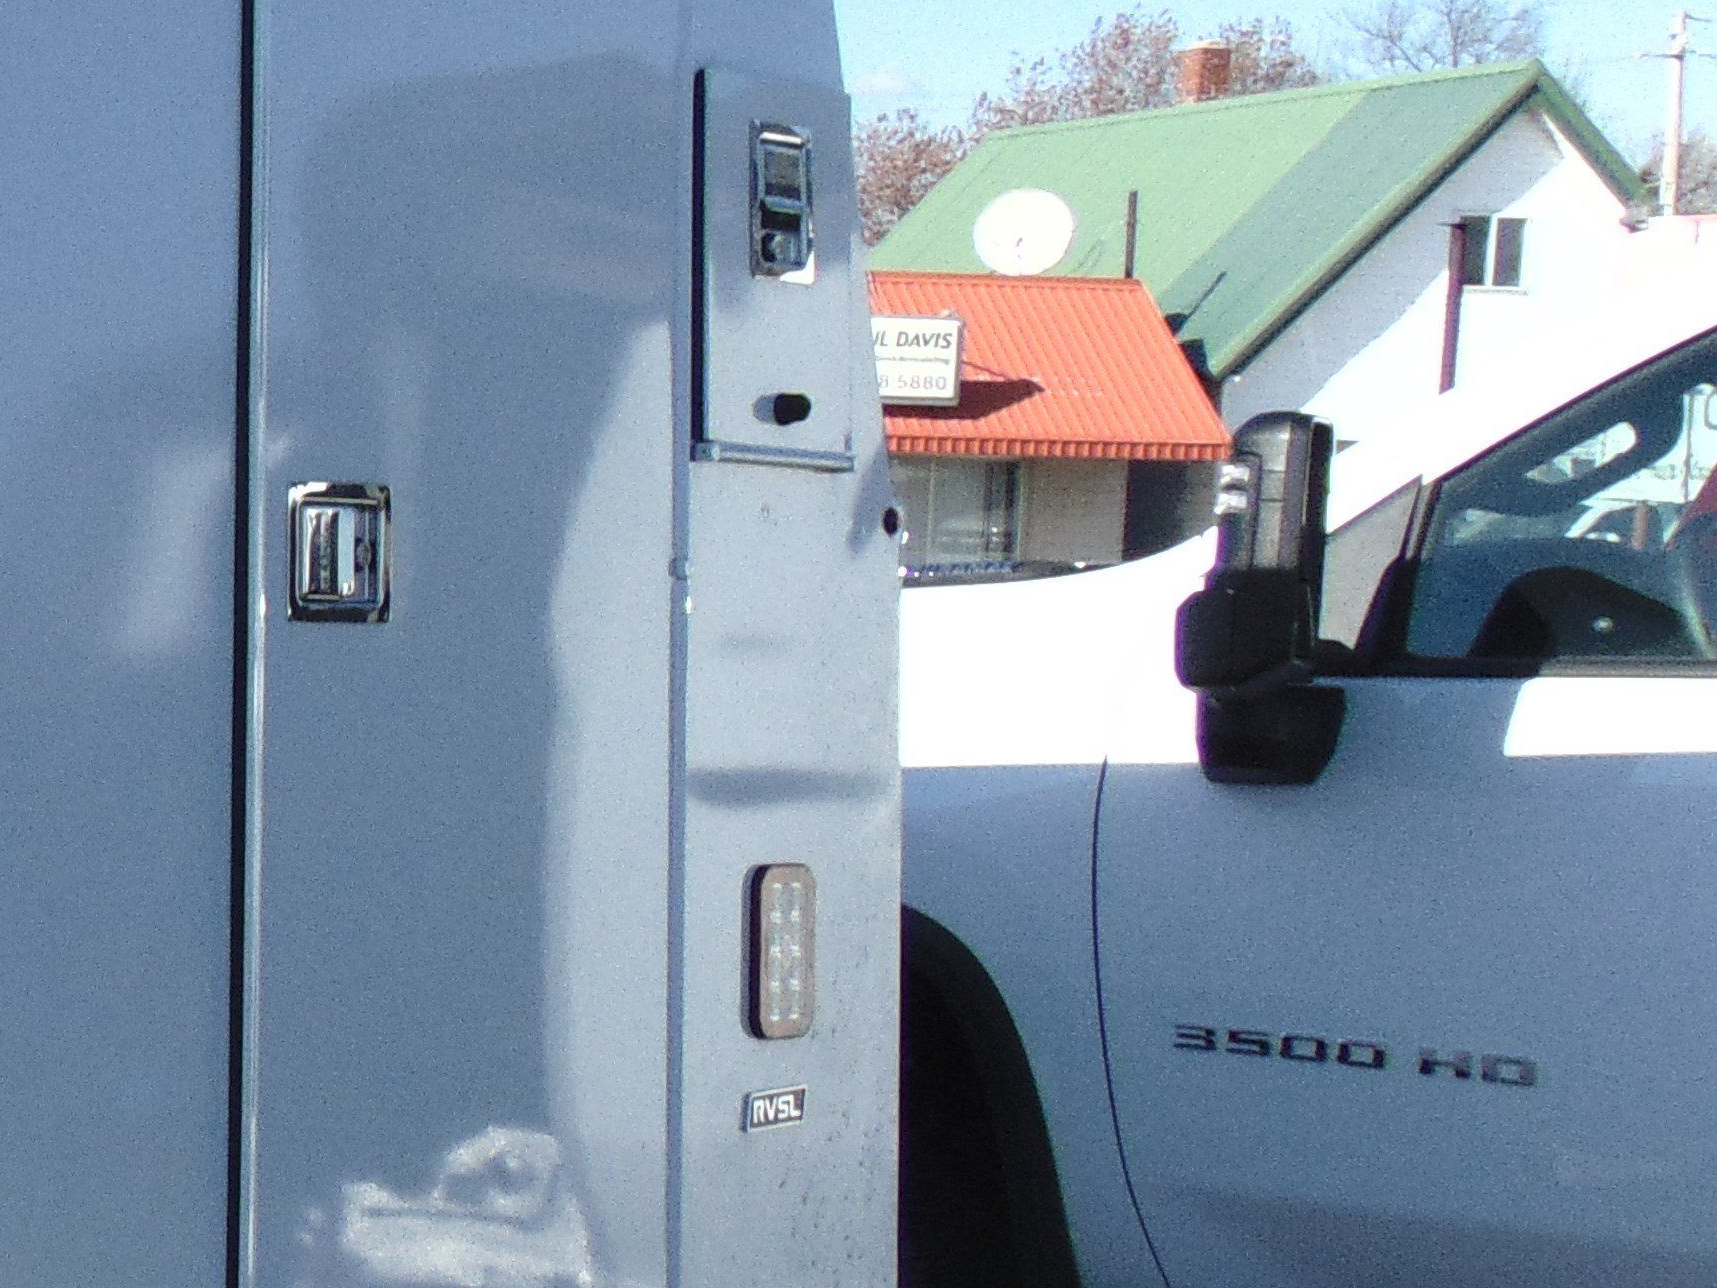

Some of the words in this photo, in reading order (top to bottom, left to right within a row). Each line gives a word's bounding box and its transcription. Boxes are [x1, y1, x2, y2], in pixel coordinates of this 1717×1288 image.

[896, 330, 954, 350] DAVIS
[1172, 1022, 1389, 1070] 3500
[1418, 1044, 1540, 1088] HD
[751, 1093, 802, 1126] RVSL
